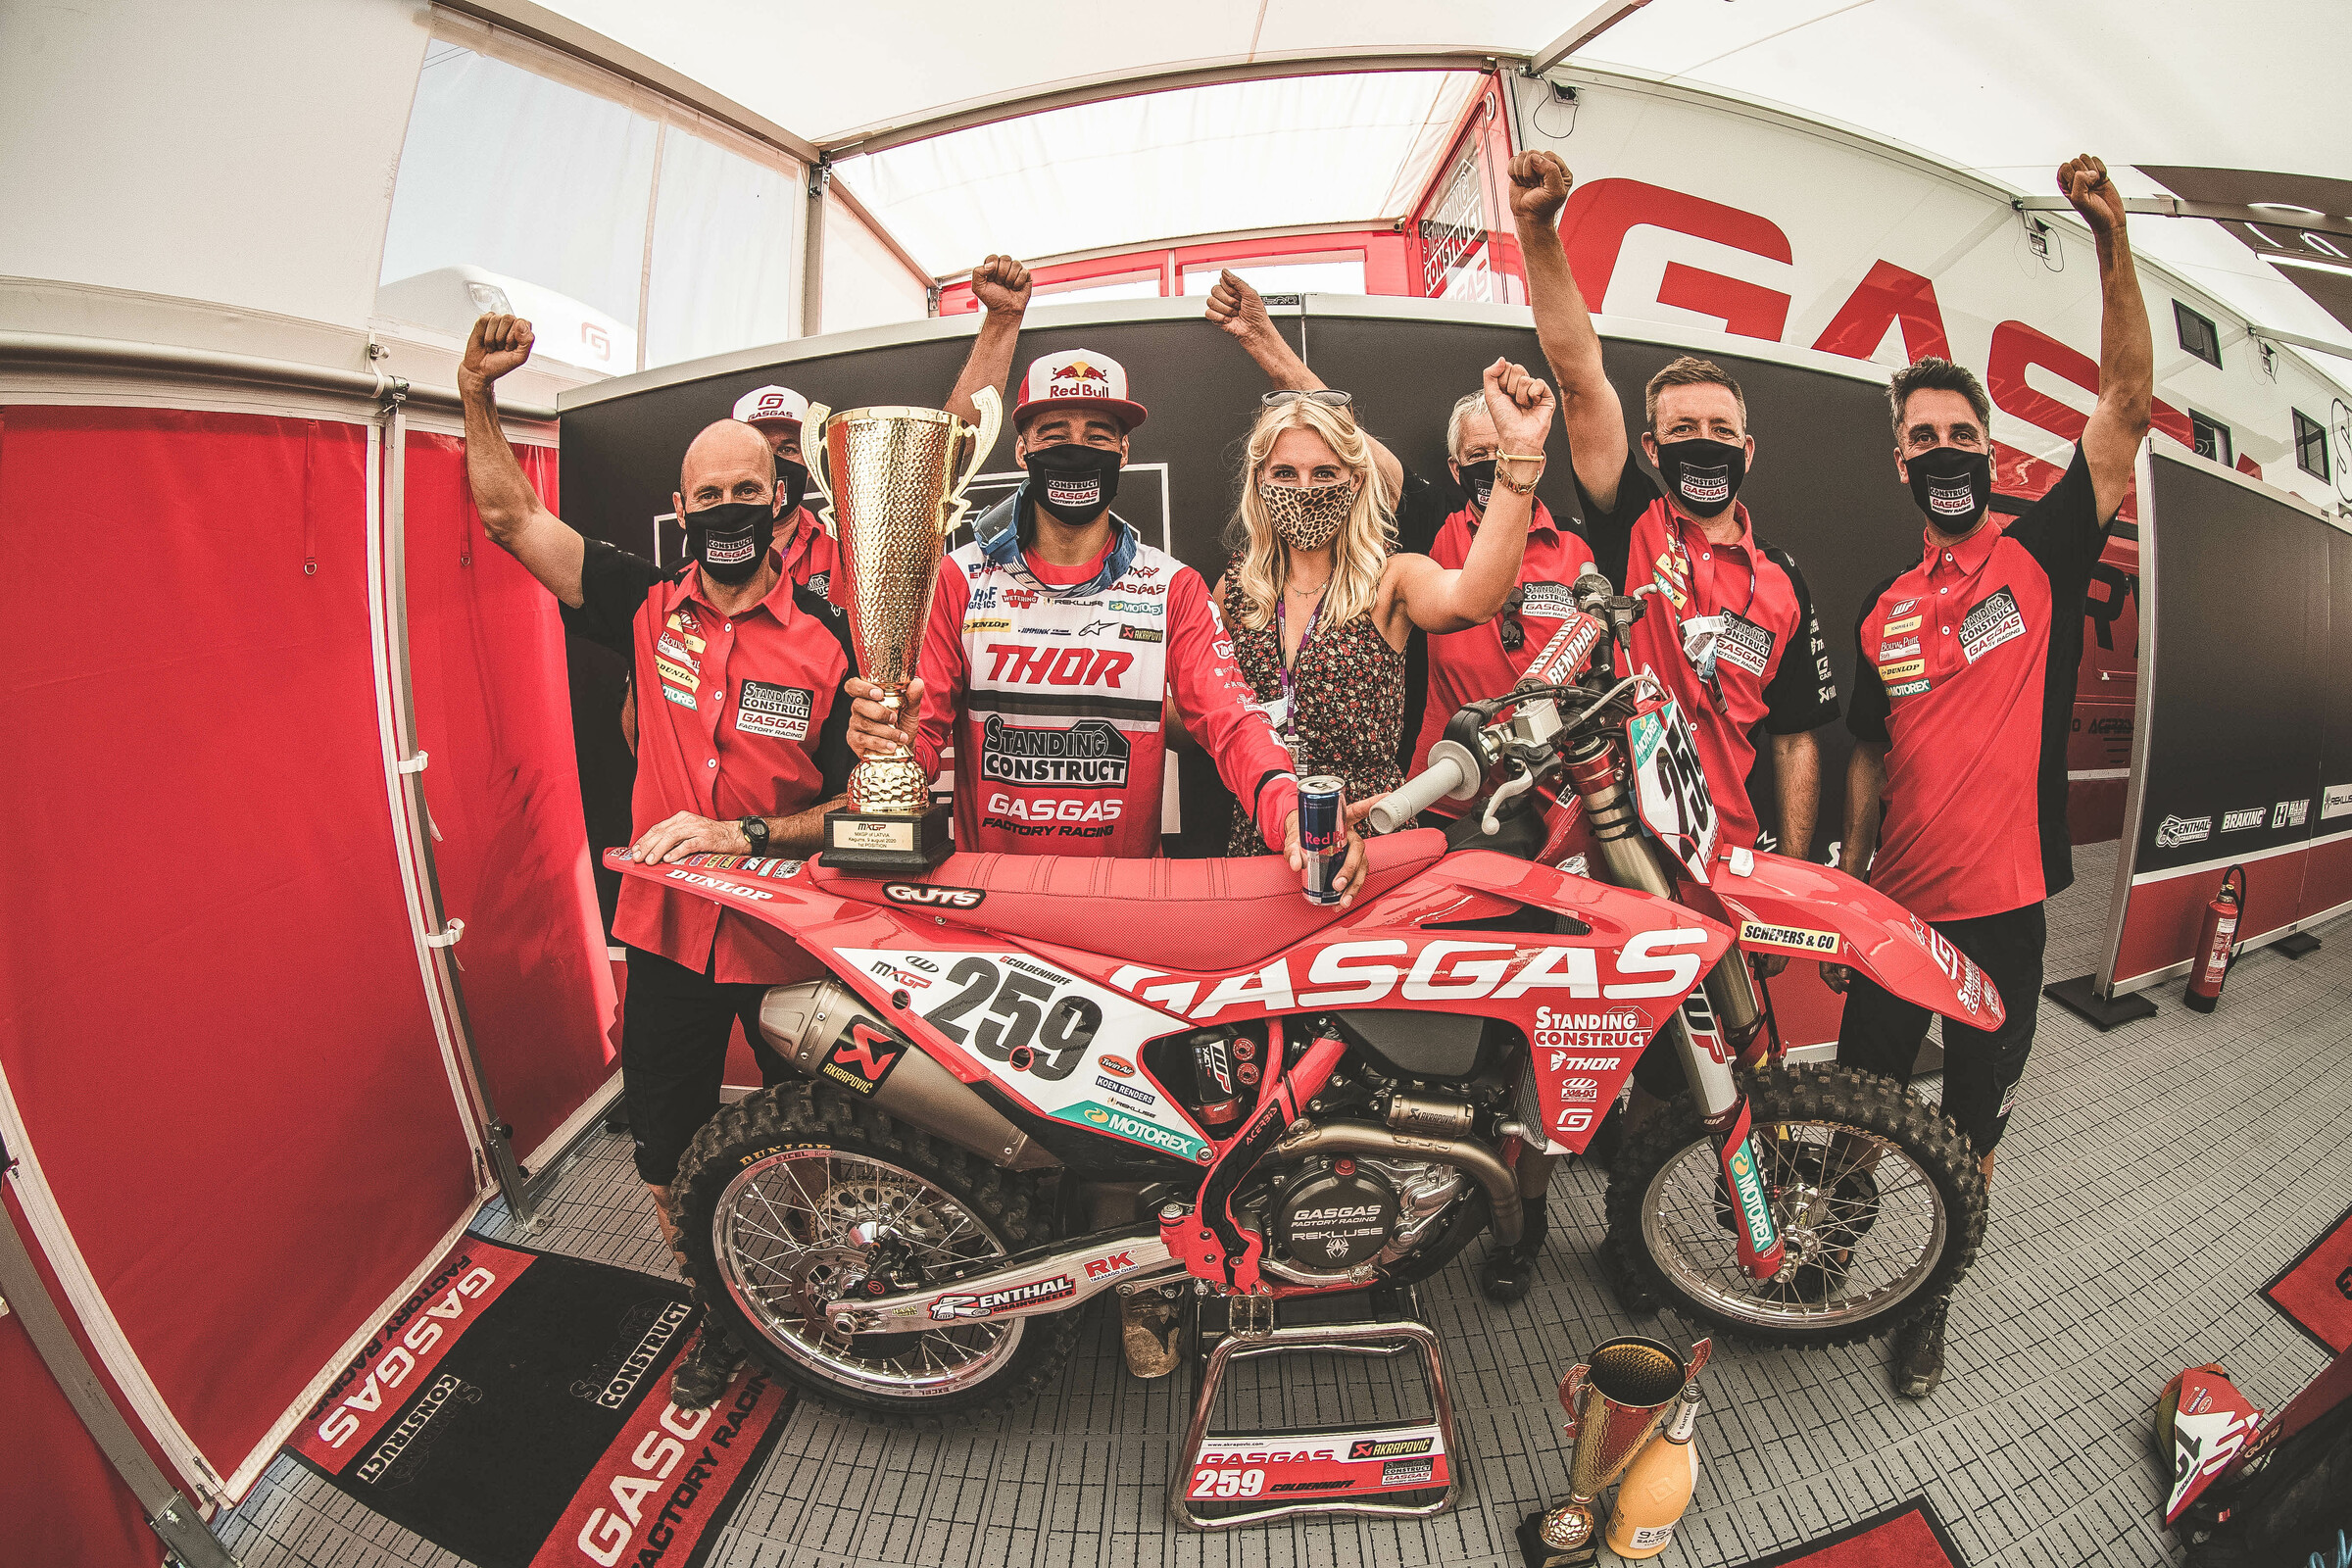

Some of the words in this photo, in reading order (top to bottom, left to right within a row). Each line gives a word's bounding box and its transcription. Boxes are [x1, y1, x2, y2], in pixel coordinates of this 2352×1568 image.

[1426, 200, 1482, 292] CONSTRUCT
[1050, 383, 1079, 398] Red
[1082, 385, 1109, 399] Bull
[748, 410, 794, 419] GASGAS
[1049, 479, 1099, 489] CONSTRUCT
[1684, 474, 1726, 486] CONSTRUCT
[1050, 490, 1099, 500] GASGAS
[1683, 484, 1727, 497] GASGAS
[1931, 486, 1970, 498] CONSTRUCT
[1932, 495, 1972, 509] GASGAS
[709, 536, 753, 549] CONSTRUCT
[710, 545, 754, 559] GASGAS
[1003, 594, 1039, 604] WETERING
[1525, 592, 1573, 605] CONSTRUCT
[1525, 603, 1575, 613] GASGAS
[1962, 601, 2016, 643] CONSTRUCT
[1726, 627, 1770, 656] ONSTRUCT
[1996, 627, 2021, 644] RACING
[1546, 620, 1598, 686] RENTHAL
[1716, 638, 1766, 668] GASGAS
[986, 643, 1135, 689] THOR
[1740, 661, 1760, 674] RACING
[1886, 663, 1920, 675] DUNLOP
[662, 685, 698, 708] OTORE
[743, 682, 805, 705] STANDING
[1890, 679, 1931, 697] MOTOREX
[743, 698, 808, 716] CONSTRUCT
[738, 722, 773, 735] FACTORY
[774, 729, 804, 739] RACING
[741, 712, 808, 732] GASGAS
[985, 714, 1108, 758] STANDING
[1635, 714, 1660, 758] MOTOREX
[985, 756, 1126, 783] CONSTRUCT
[987, 793, 1124, 822] GASGAS
[2329, 794, 2352, 806] REKLUS
[858, 822, 887, 831] MXGP
[981, 817, 1057, 837] FACTORY
[1057, 825, 1114, 838] RACING
[2223, 809, 2264, 831] BRAKING
[1304, 830, 1331, 846] Red
[665, 868, 774, 901] DUNLOP
[887, 885, 980, 906] GUTS
[1743, 924, 1806, 946] SCHEPERS
[1805, 934, 1815, 948] &
[1816, 934, 1836, 951] CO
[869, 959, 933, 990] MXGP
[1108, 927, 1708, 1019] GASGAS
[923, 955, 1103, 1082] 259
[1535, 1005, 1638, 1030] STANDING
[1535, 1031, 1652, 1047] CONSTRUCT
[1100, 1057, 1120, 1071] Twin
[1119, 1063, 1135, 1075] Air
[1201, 1047, 1211, 1069] XACT
[1565, 1057, 1622, 1071] THOR
[1097, 1076, 1118, 1092] KOEN
[1118, 1086, 1154, 1104] RENDERS
[1115, 1100, 1156, 1119] REKLUSE
[1108, 1113, 1194, 1154] MOTOREX
[775, 1151, 809, 1163] EXCEL
[1294, 1204, 1382, 1221] GASGAS
[1738, 1171, 1772, 1250] MOTOREX
[1291, 1218, 1339, 1228] FACTORY
[1338, 1216, 1377, 1225] RACING
[1292, 1227, 1384, 1241] REKLUSE
[1083, 1251, 1135, 1278] RK
[1090, 1270, 1120, 1283] TAKASAGO
[1120, 1264, 1139, 1275] CHAIN
[381, 1254, 473, 1346] FACTORY
[993, 1289, 1074, 1313] CHAINWHEELS
[318, 1266, 496, 1448] GASGAS
[597, 1300, 692, 1409] CONSTRUCT
[307, 1338, 384, 1421] RACING
[710, 1370, 775, 1454] RACIN
[1678, 1403, 1694, 1431] SANTERO
[356, 1373, 462, 1485] CONSTRUCT
[1373, 1438, 1431, 1456] AKRAPOVIČ
[1200, 1449, 1337, 1466] GASGAS
[577, 1390, 721, 1568] GASG
[1385, 1465, 1431, 1475] CONSTRUCT
[1385, 1472, 1430, 1481] GASGAS
[1192, 1468, 1266, 1497] 259
